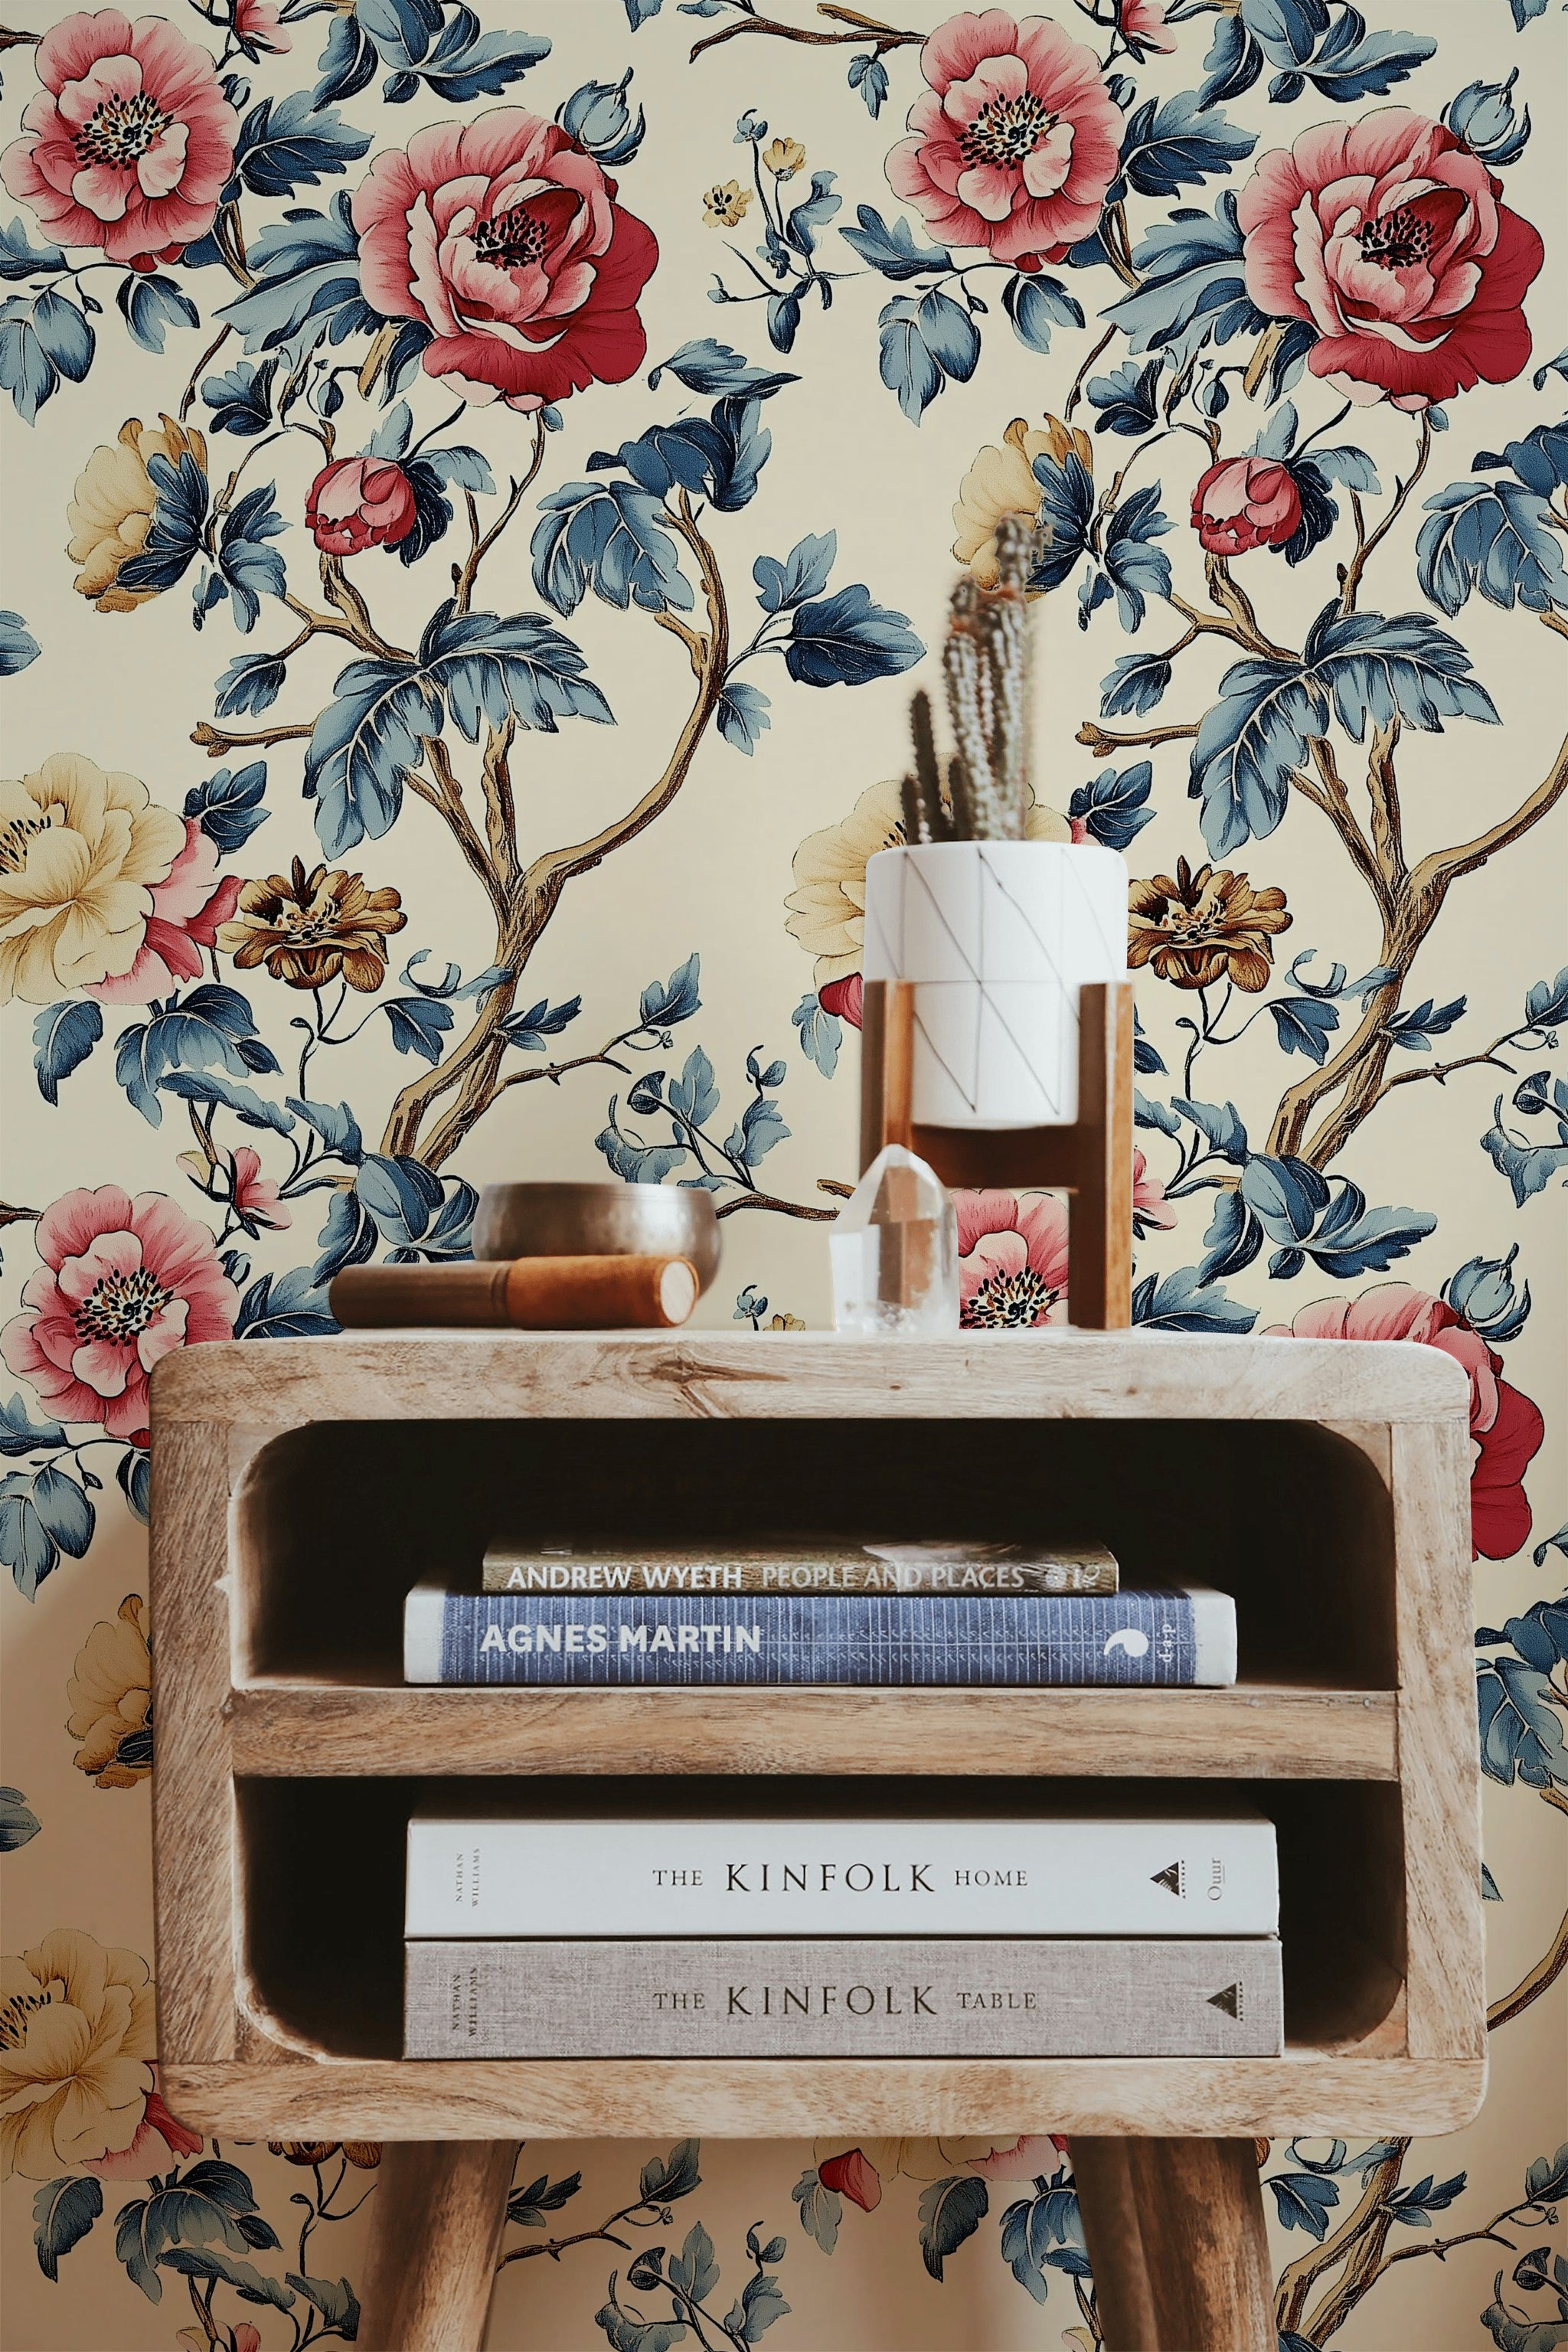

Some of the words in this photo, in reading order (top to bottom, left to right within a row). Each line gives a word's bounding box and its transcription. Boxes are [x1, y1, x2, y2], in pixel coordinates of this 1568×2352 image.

[507, 1566, 632, 1589] ANDREW
[642, 1566, 742, 1589] WYETH
[762, 1566, 856, 1588] PEOPLE
[864, 1566, 921, 1589] AND
[931, 1566, 1025, 1589] PLACES
[479, 1624, 608, 1653] AGNES
[619, 1625, 761, 1653] MARTIN
[472, 1847, 480, 1907] WILLIAMS
[652, 1869, 704, 1886] THE
[725, 1863, 936, 1893] KINFOLK
[954, 1869, 1030, 1886] HOME
[452, 1974, 461, 2030] NATHAN
[468, 1968, 478, 2037] WILLIAMS
[652, 1992, 706, 2011] THE
[727, 1985, 938, 2016] KINFOLK
[956, 1992, 1038, 2011] TABLE
